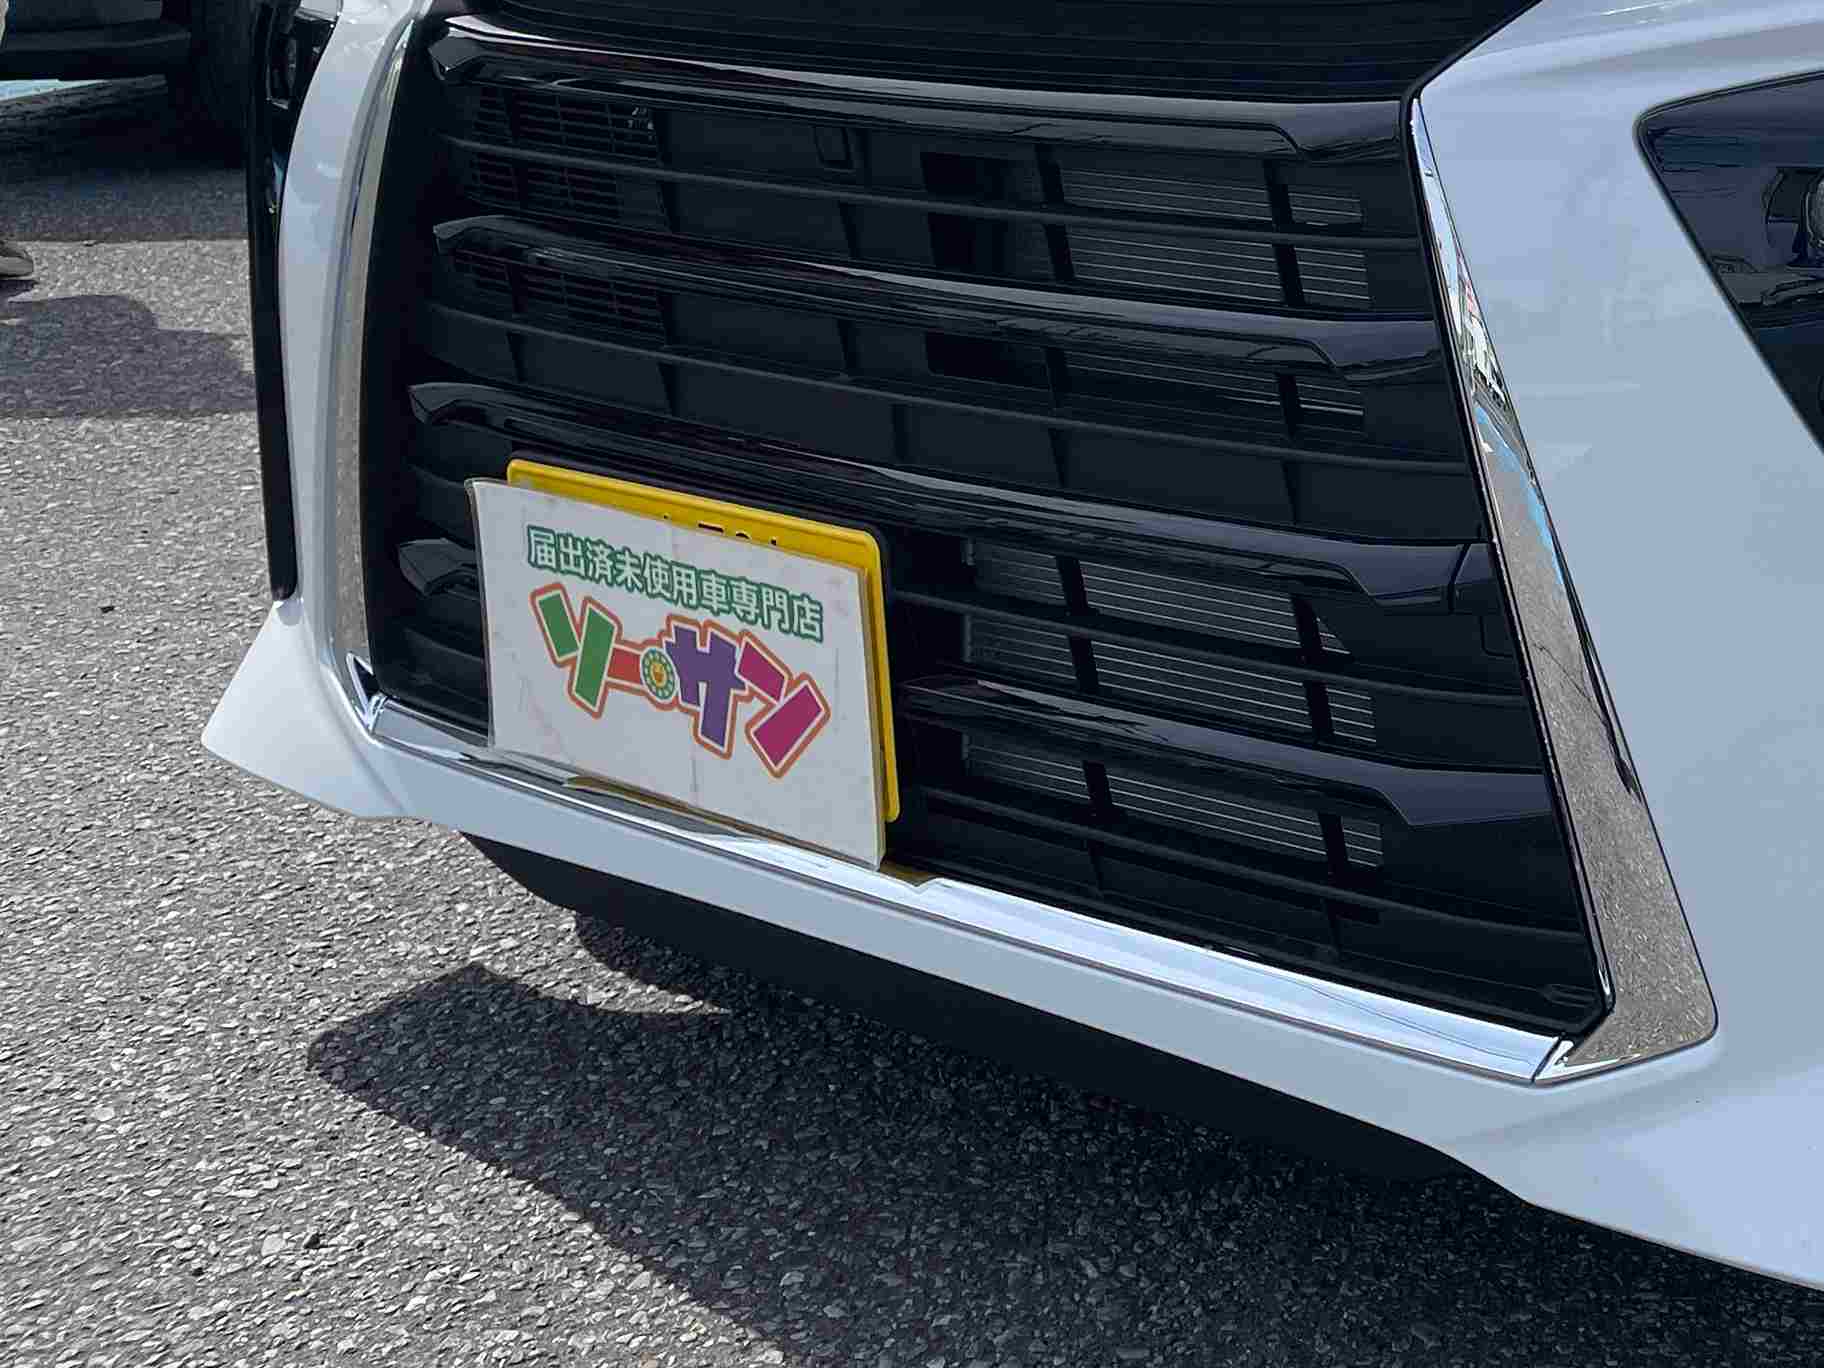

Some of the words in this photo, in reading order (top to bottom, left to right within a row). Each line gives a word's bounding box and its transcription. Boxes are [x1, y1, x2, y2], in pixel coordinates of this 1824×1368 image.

[527, 526, 824, 644] 届出済未使用車専門店
